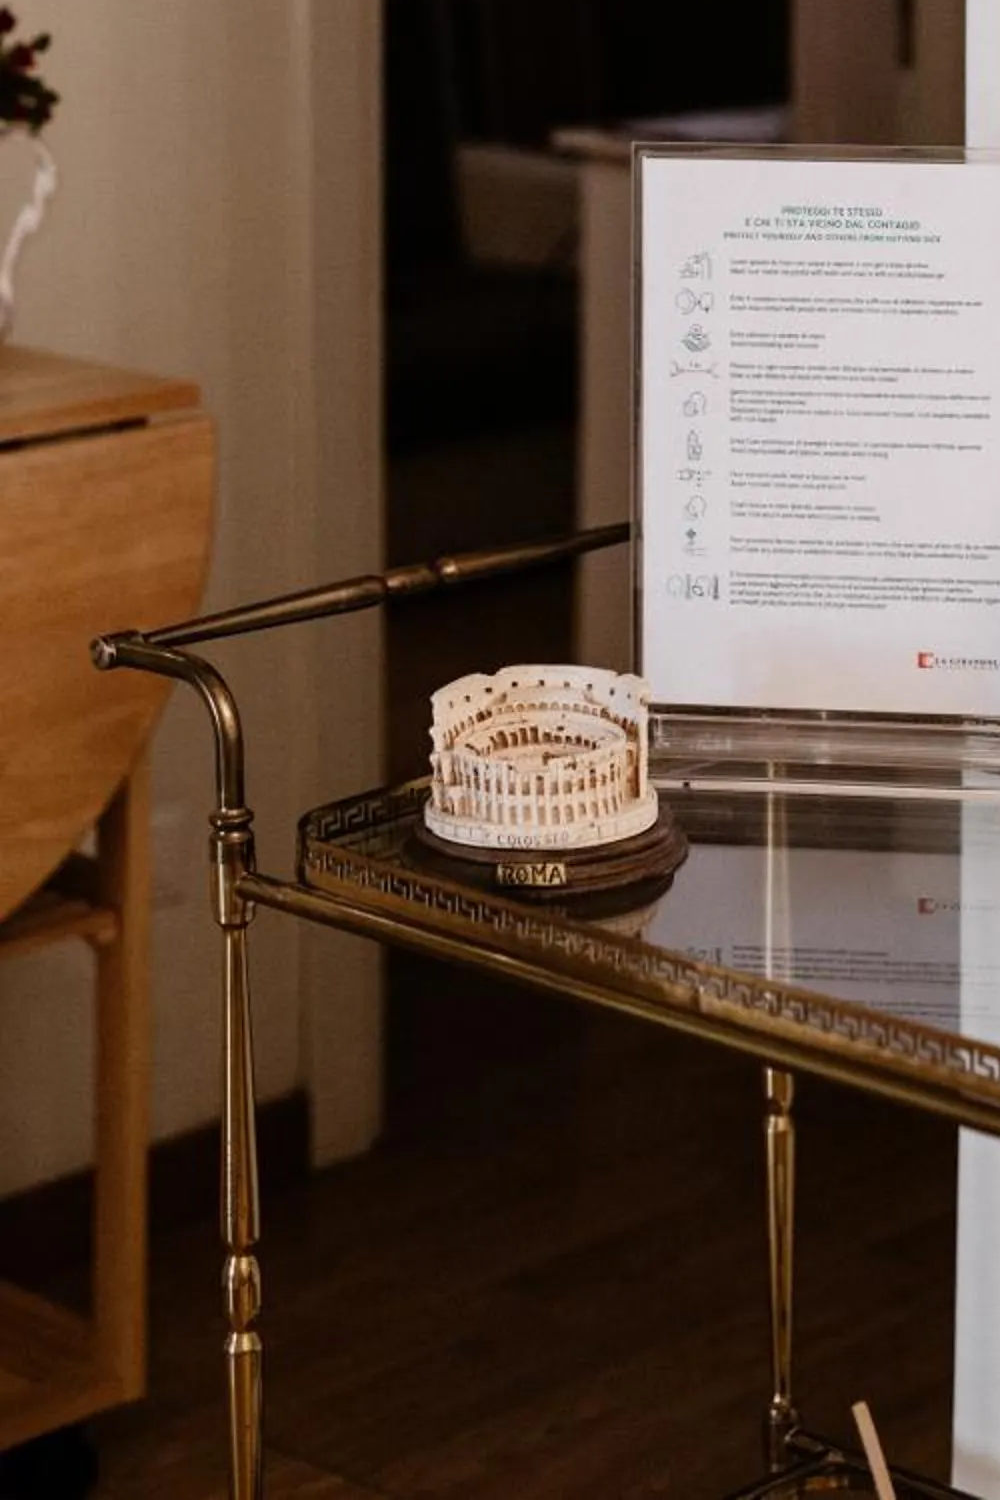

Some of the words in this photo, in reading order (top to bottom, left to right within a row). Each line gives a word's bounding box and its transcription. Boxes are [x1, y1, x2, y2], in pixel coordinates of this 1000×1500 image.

[845, 219, 863, 229] DAL
[867, 219, 920, 231] CONTAGIO
[502, 862, 563, 884] ROMA
